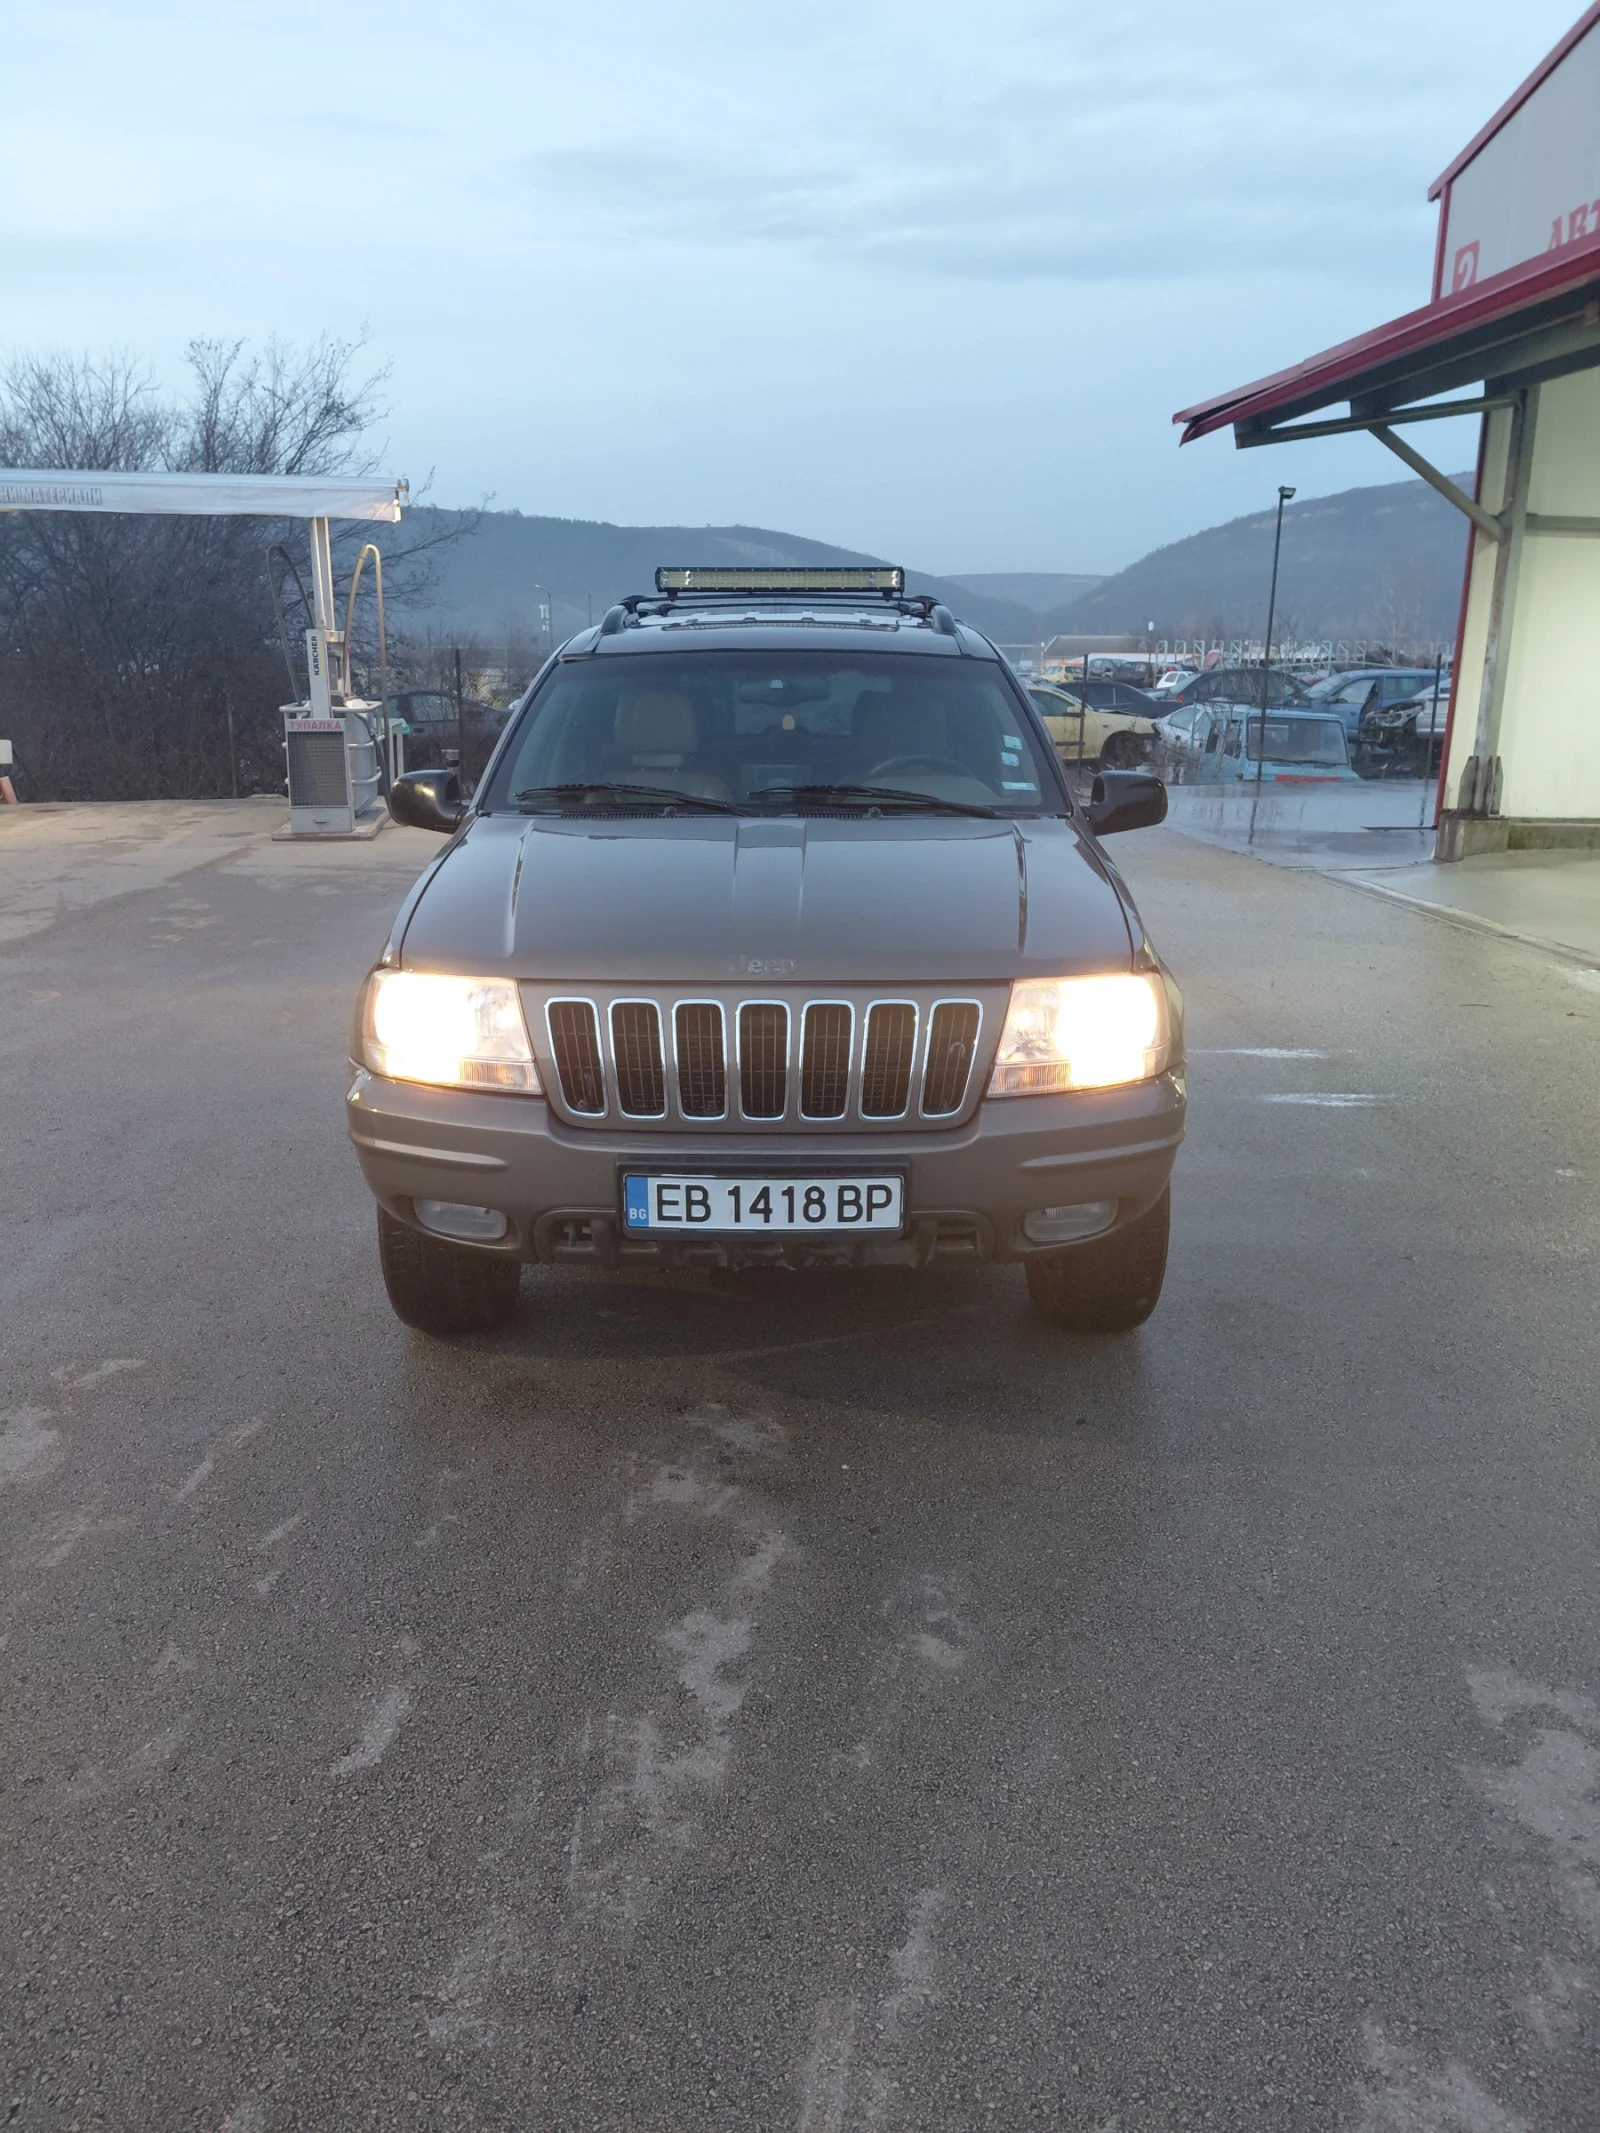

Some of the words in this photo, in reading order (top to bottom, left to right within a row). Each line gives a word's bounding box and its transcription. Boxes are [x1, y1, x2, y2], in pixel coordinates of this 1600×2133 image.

[20, 486, 102, 505] МАТЕРИАЛИ
[289, 720, 342, 730] ТУПАЛКА
[728, 954, 798, 979] Jeep
[656, 1184, 711, 1222] EB
[728, 1185, 827, 1223] 1418
[837, 1184, 892, 1222] BP
[629, 1208, 647, 1220] BG
